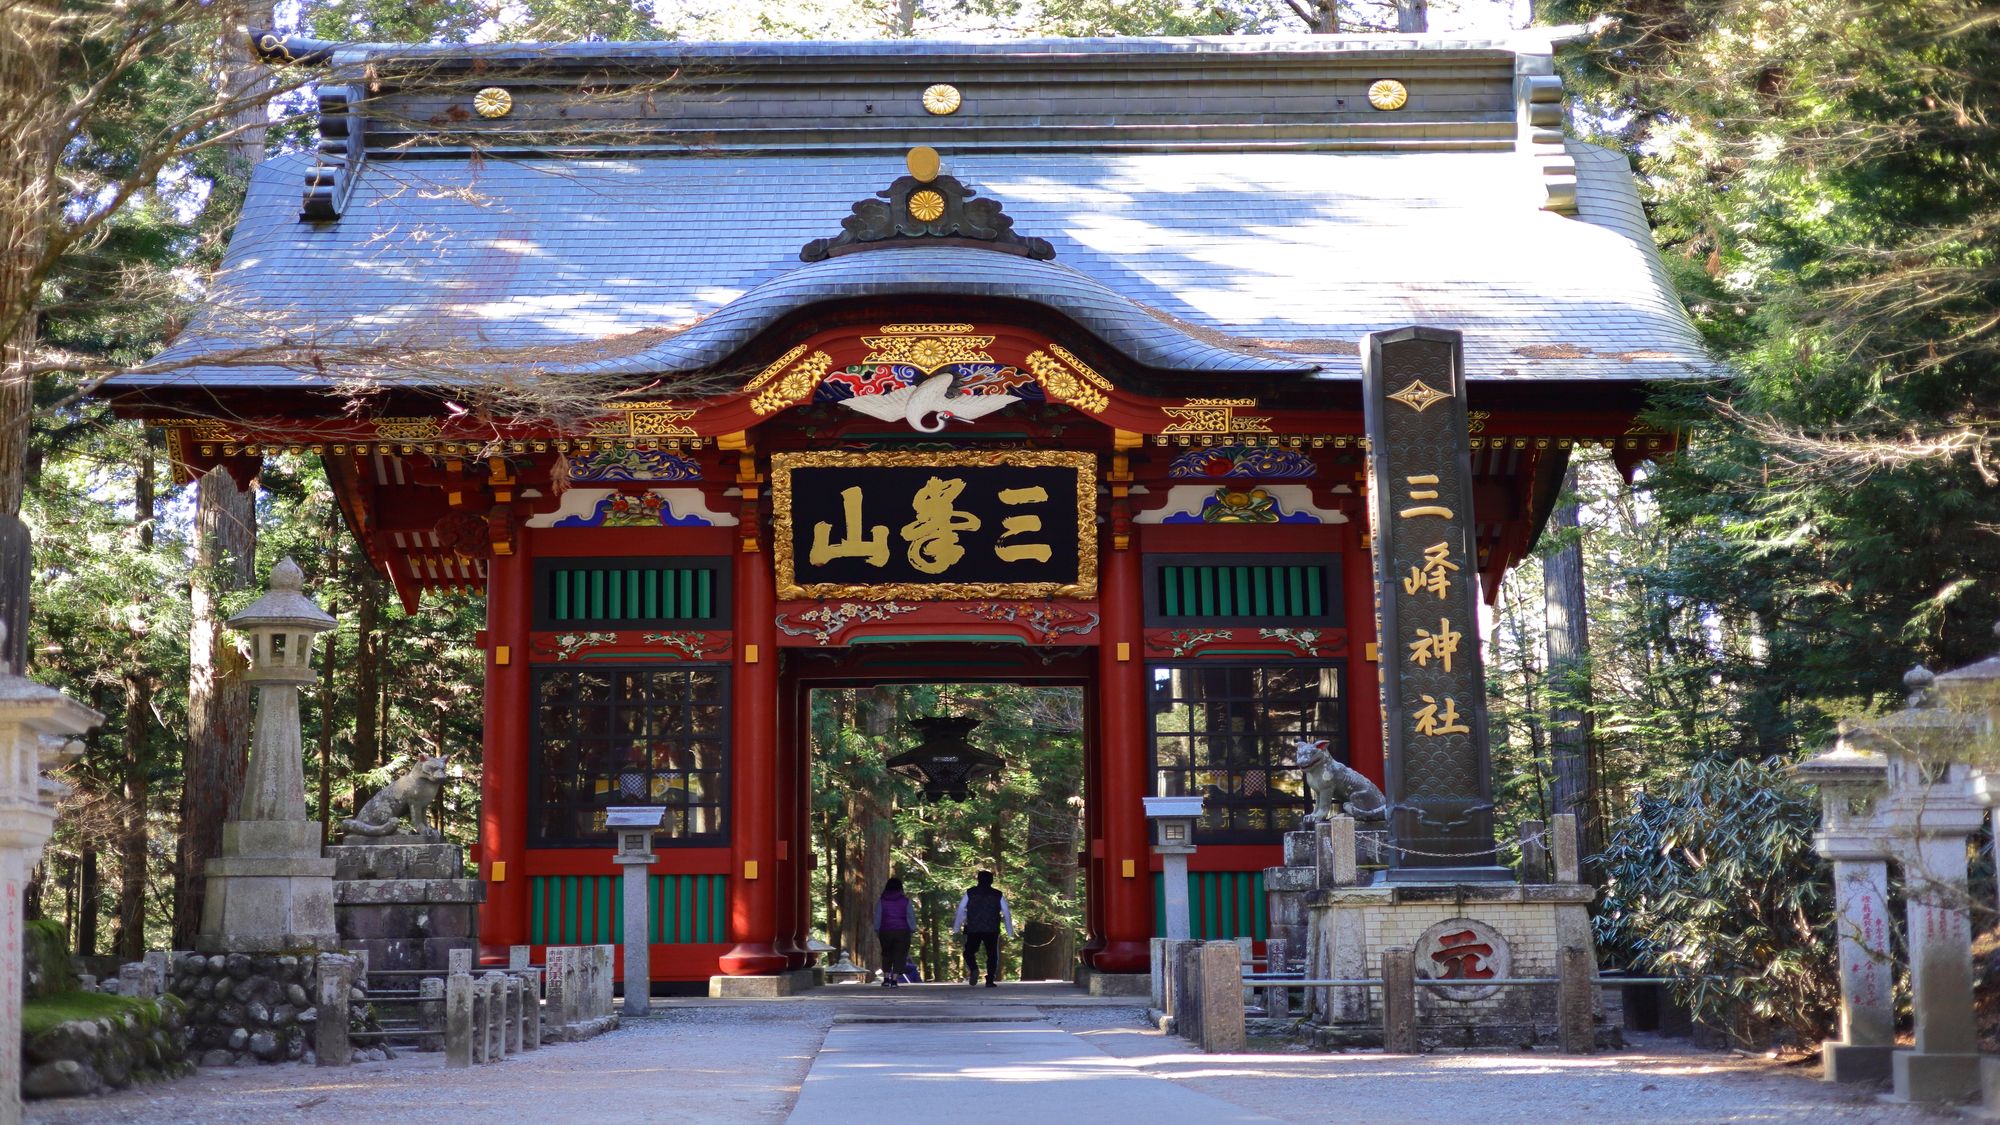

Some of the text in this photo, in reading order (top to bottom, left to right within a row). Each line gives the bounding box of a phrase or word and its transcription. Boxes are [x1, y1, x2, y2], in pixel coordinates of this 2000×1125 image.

[1400, 474, 1470, 737] 三峰神社
[1431, 929, 1494, 981] 元
